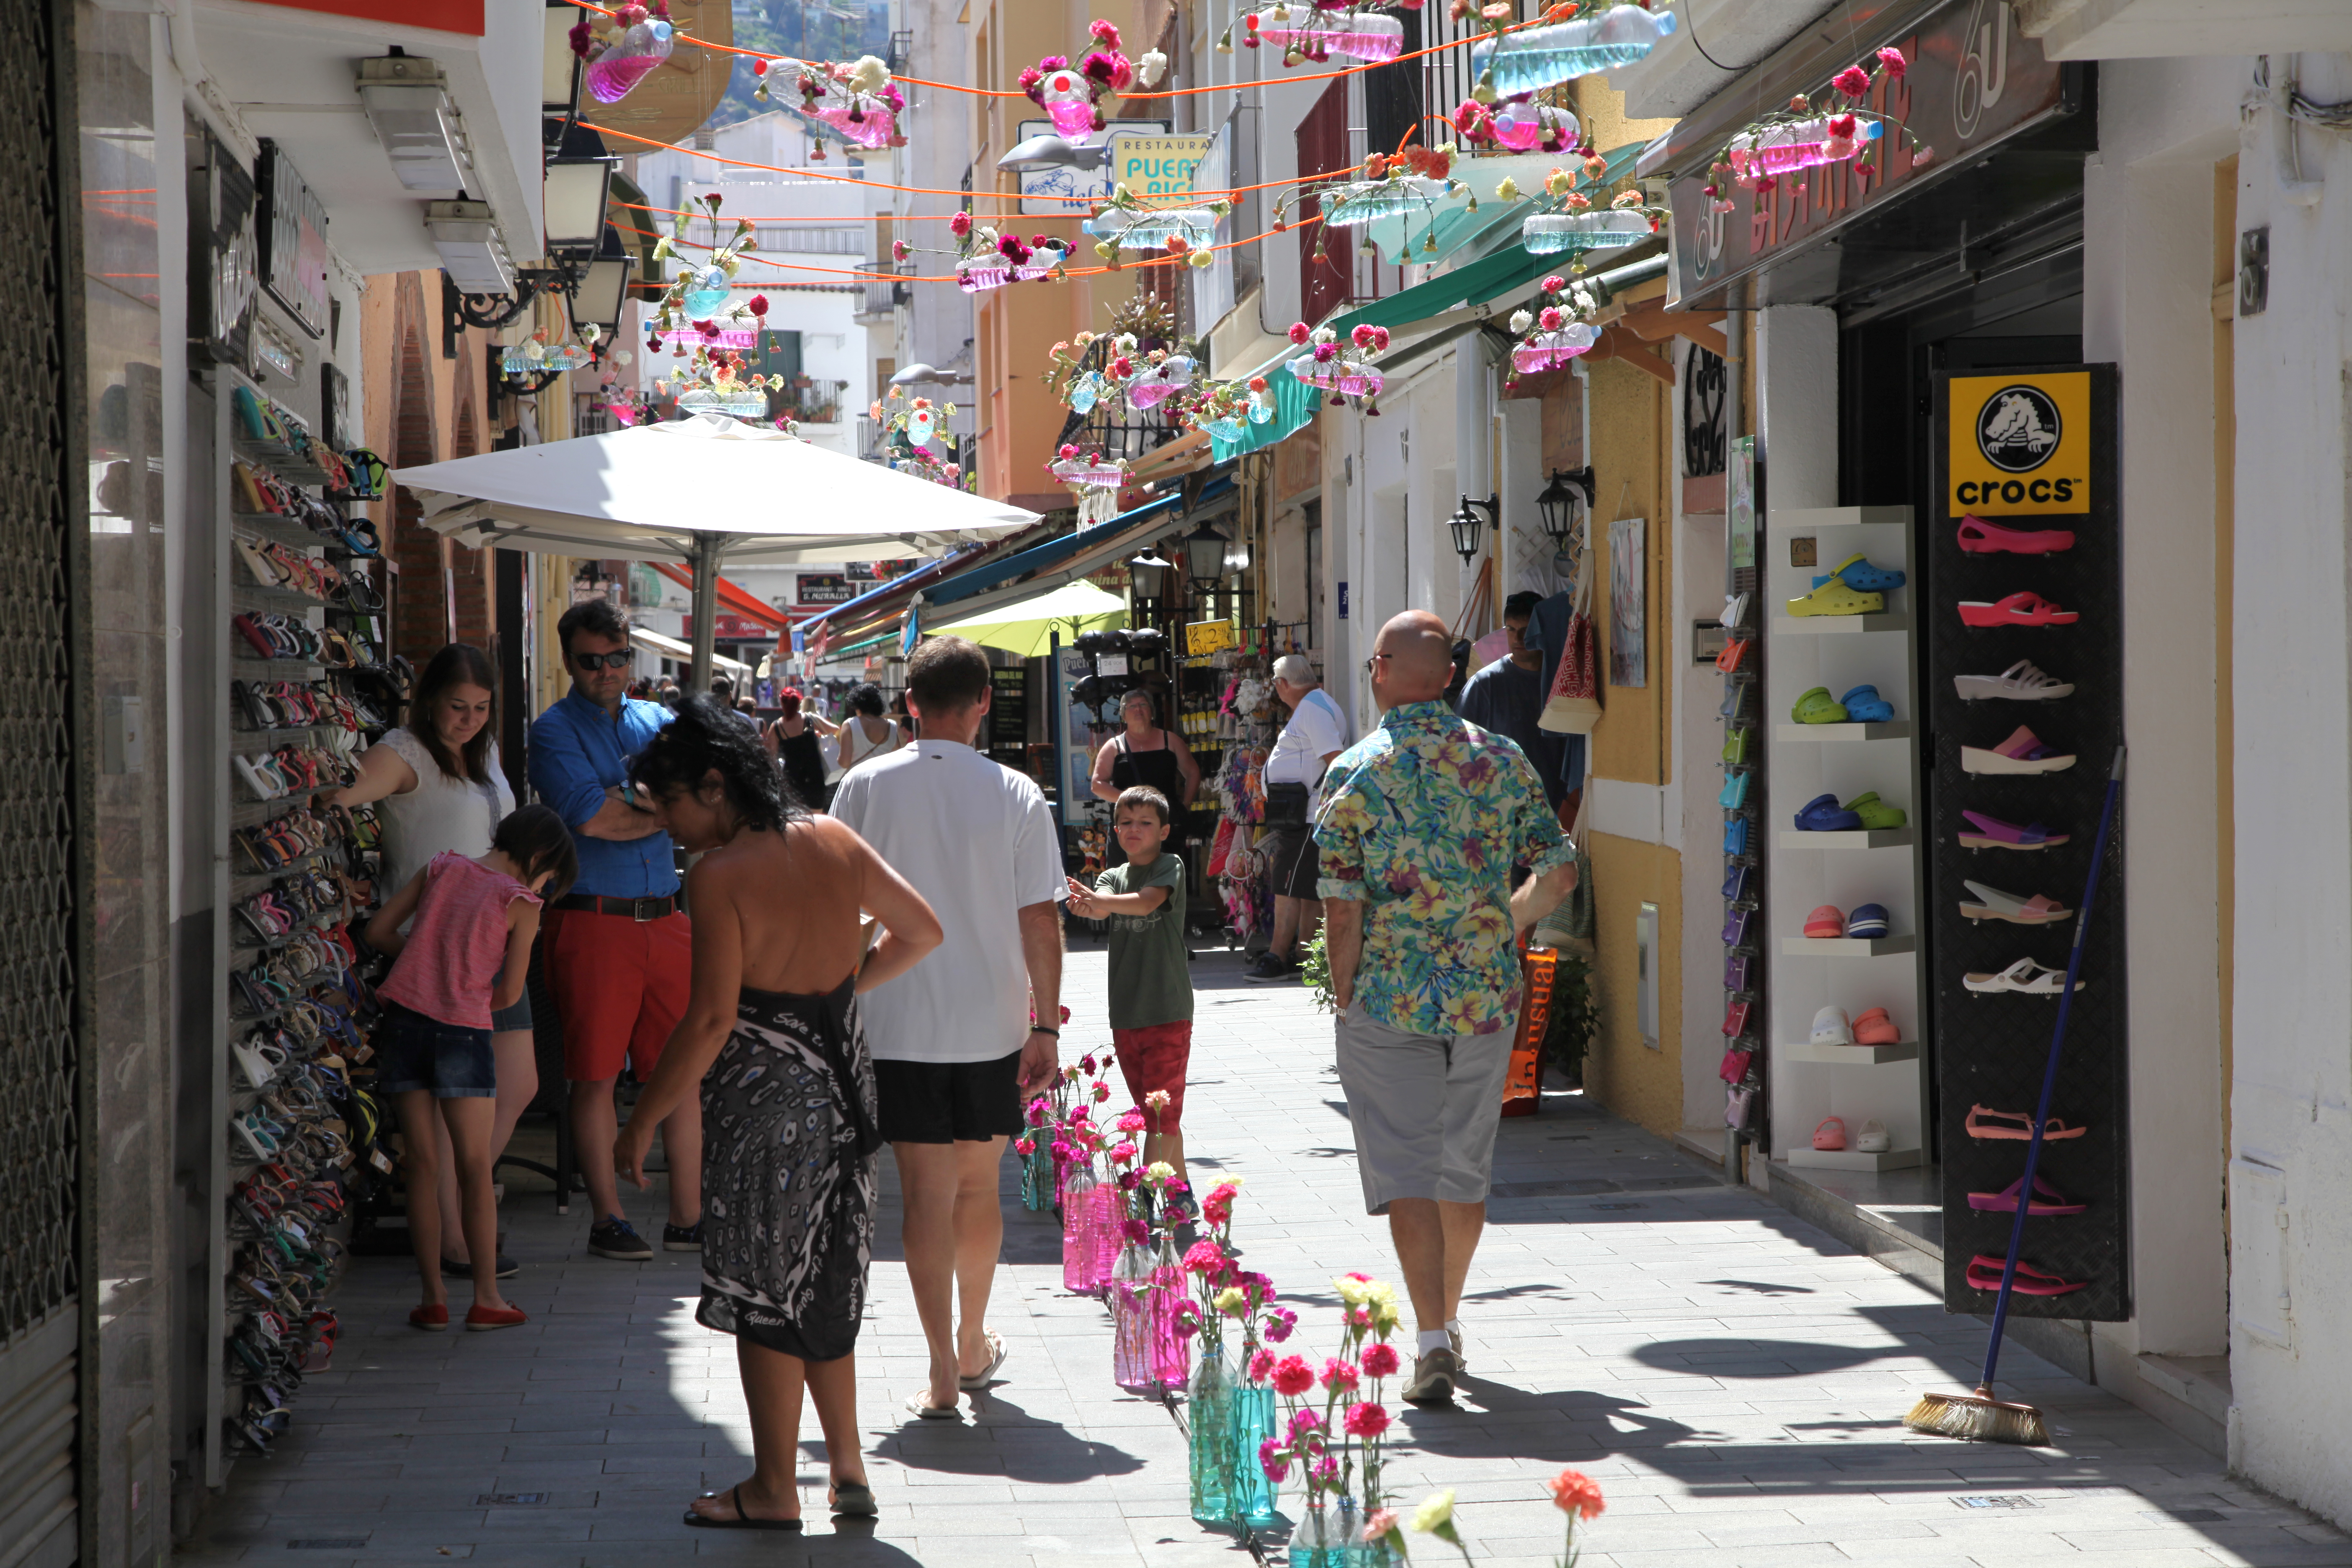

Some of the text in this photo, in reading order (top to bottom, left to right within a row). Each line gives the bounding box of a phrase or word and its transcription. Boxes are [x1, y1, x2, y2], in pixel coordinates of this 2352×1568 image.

[659, 76, 701, 93] GRILL
[1957, 478, 2073, 505] crocs
[773, 1012, 809, 1035] Save
[744, 1310, 786, 1327] Queen
